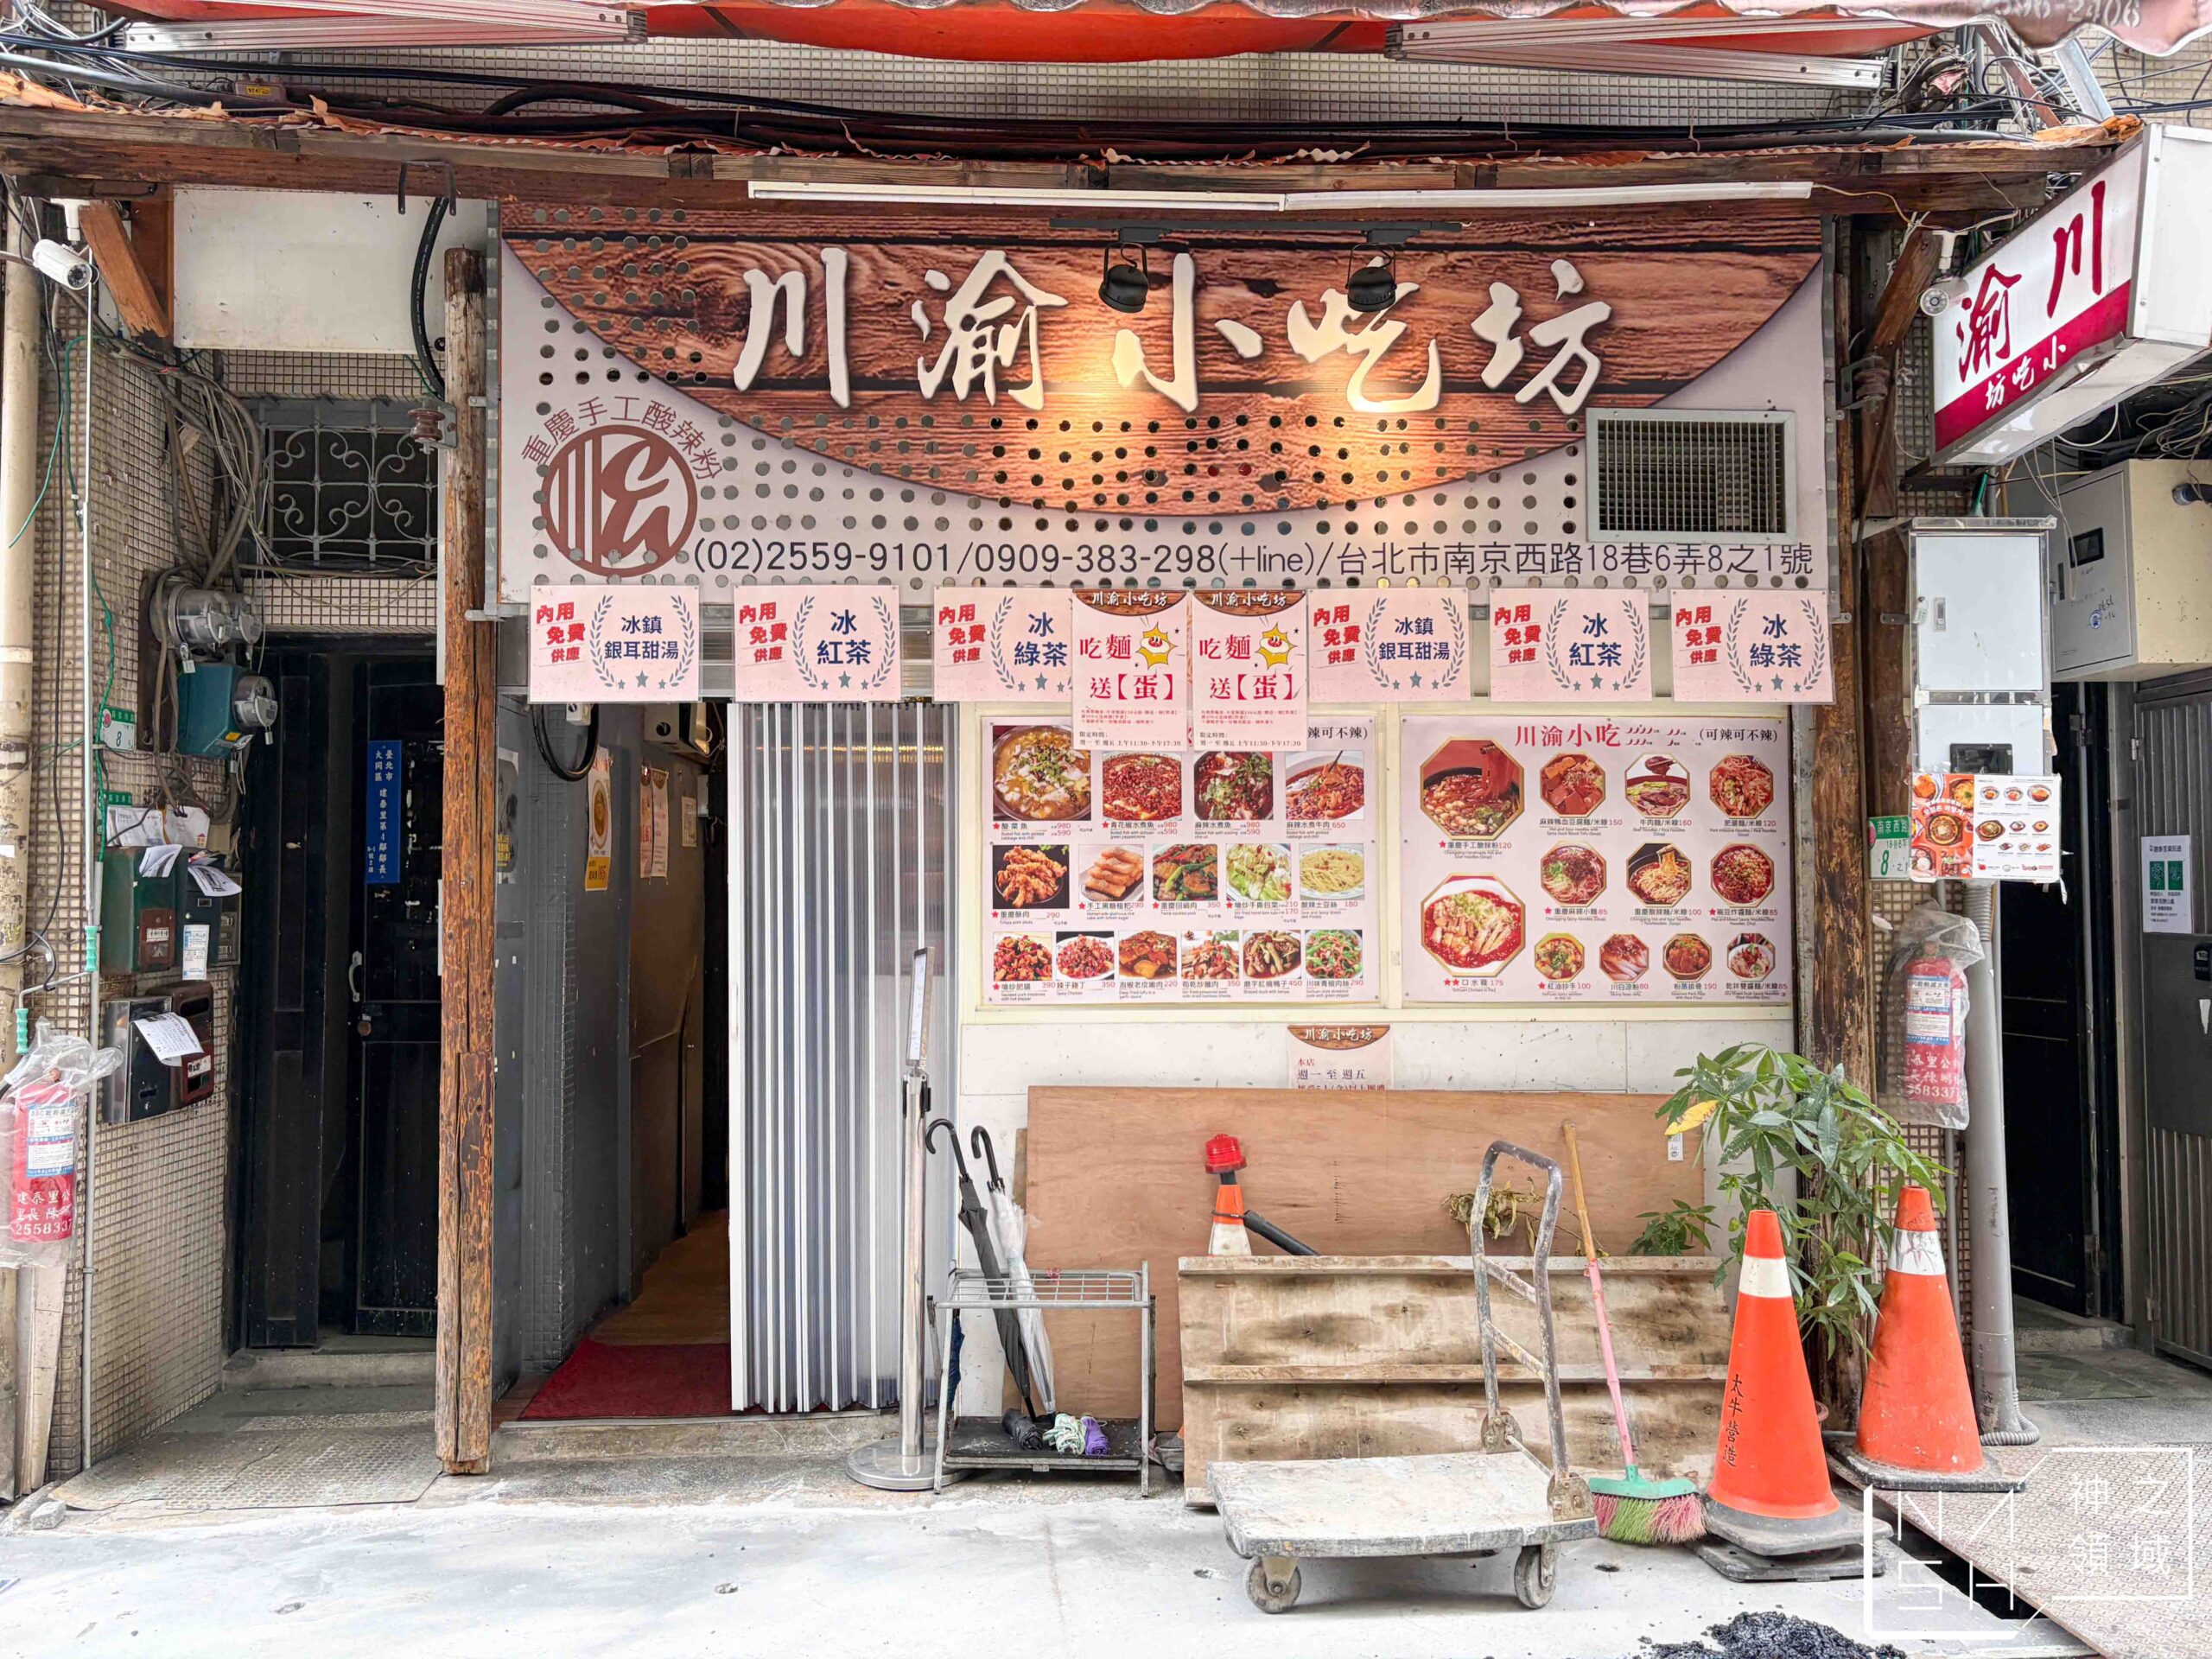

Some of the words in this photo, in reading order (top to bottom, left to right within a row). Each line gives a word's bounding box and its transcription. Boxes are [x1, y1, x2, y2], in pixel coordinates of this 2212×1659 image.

[734, 247, 1611, 416] 川渝小吃坊
[1985, 335, 2066, 410] 小吃坊
[521, 396, 723, 480] 重慶手工酸辣粉
[1091, 592, 1168, 609] 川渝小吃坊
[1211, 592, 1287, 609] 川渝小吃坊
[620, 615, 663, 634] 冰鎮
[830, 609, 858, 633] 冰
[1028, 613, 1055, 636] 冰
[1395, 617, 1434, 636] 冰鎮
[1582, 613, 1609, 636] 冰
[1762, 613, 1789, 636] 冰
[546, 623, 585, 645] 免費
[749, 622, 787, 645] 免費
[949, 623, 986, 645] 免費
[1323, 626, 1360, 647] 免費
[1503, 626, 1541, 647] 免費
[1685, 627, 1723, 648] 免費
[550, 646, 581, 664] 供應
[605, 640, 679, 661] 銀耳甜湯
[753, 646, 783, 664] 供應
[817, 639, 872, 665] 紅茶
[952, 648, 981, 664] 供應
[1014, 640, 1069, 668] 綠茶
[1079, 633, 1132, 660] 吃麵
[1199, 633, 1251, 660] 吃麵
[1327, 648, 1355, 664] 供應
[1378, 641, 1451, 661] 銀耳甜湯
[1508, 648, 1536, 664] 供應
[1569, 643, 1623, 668] 紅茶
[1689, 649, 1718, 665] 供應
[1750, 643, 1802, 669] 綠茶
[1090, 672, 1174, 701] 送【蛋】
[1210, 672, 1294, 701] 送【蛋】
[116, 731, 122, 747] 8
[1516, 724, 1621, 747] 川渝小吃
[1880, 849, 1890, 875] 8
[1305, 1027, 1373, 1041] 川渝小吃坊
